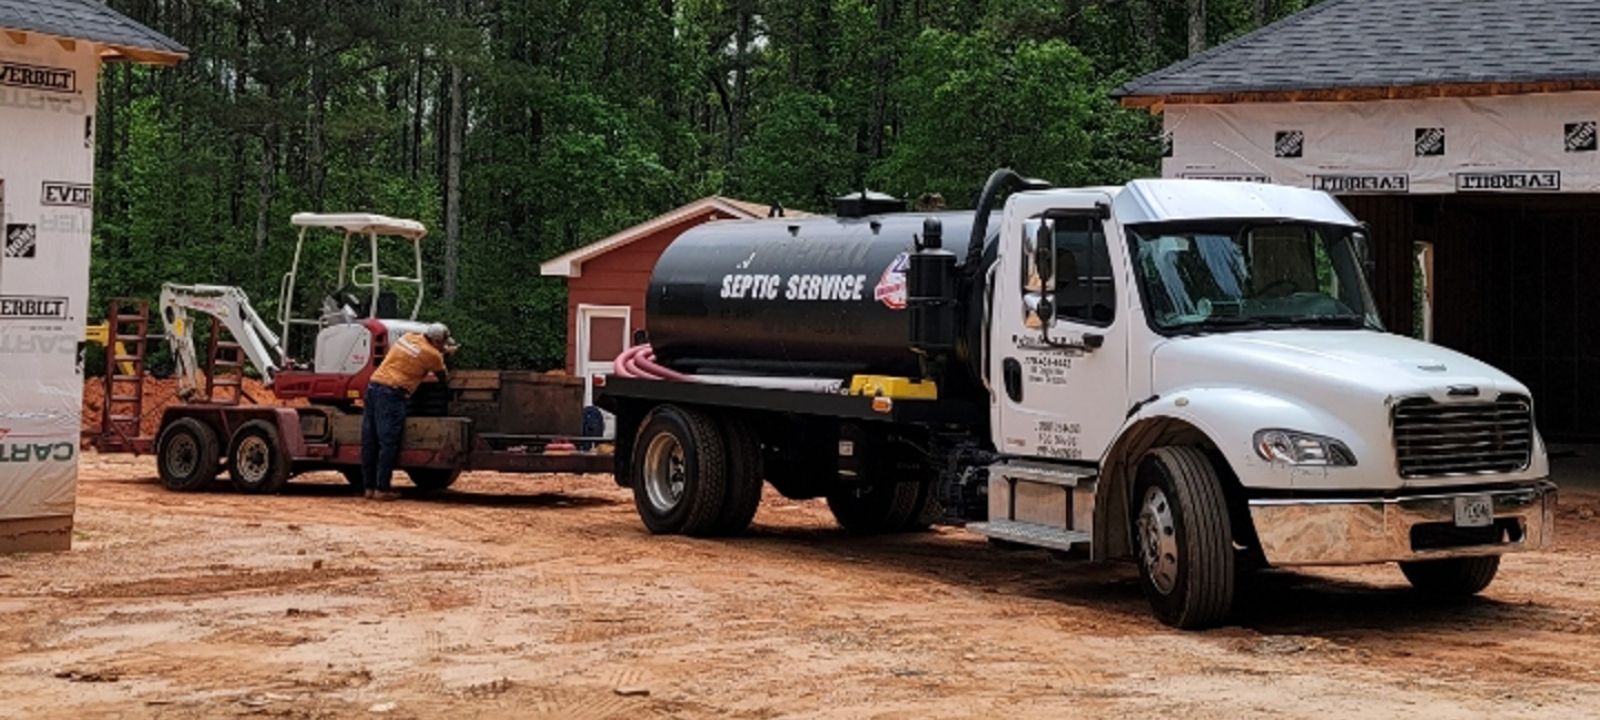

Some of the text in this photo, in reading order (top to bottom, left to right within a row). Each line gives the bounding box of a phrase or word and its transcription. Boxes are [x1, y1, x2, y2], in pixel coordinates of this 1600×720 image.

[1461, 173, 1556, 189] EVERBILT
[720, 273, 781, 300] SEPTIC
[785, 274, 867, 301] SERVICE
